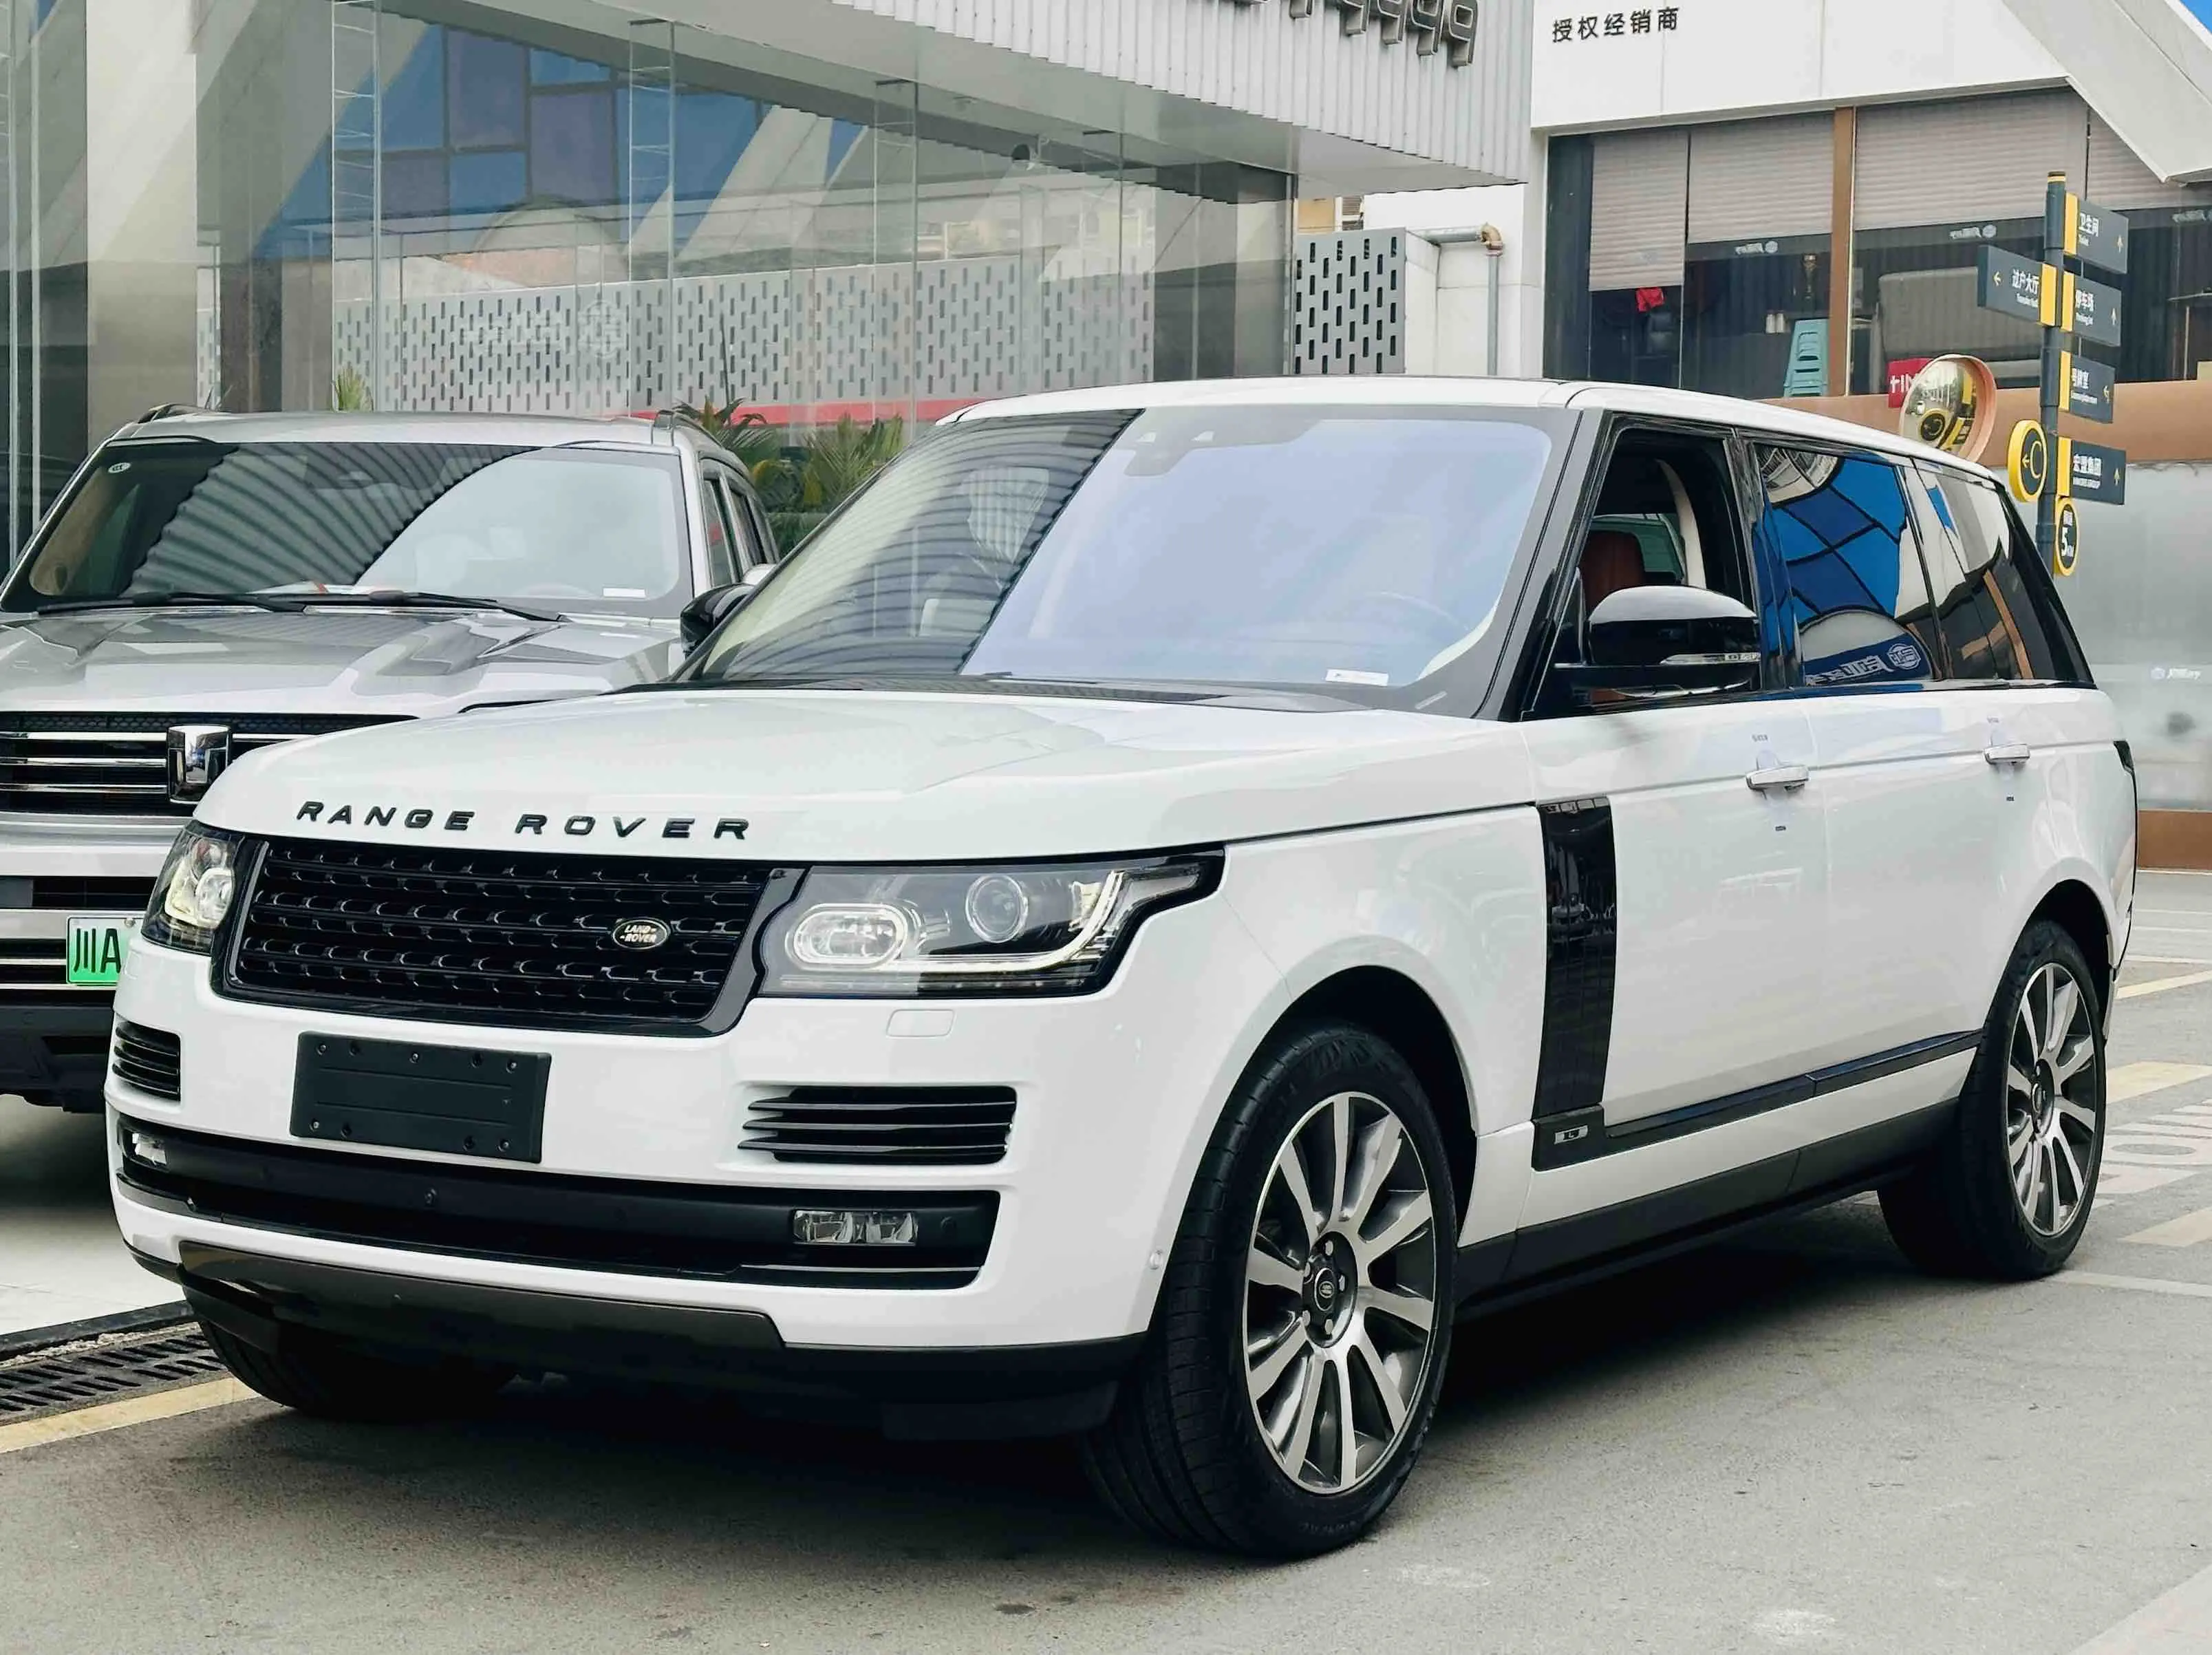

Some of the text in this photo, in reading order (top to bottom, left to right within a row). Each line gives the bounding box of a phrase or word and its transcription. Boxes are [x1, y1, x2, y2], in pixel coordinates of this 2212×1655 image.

[1552, 6, 1679, 43] 授权经销商
[2079, 212, 2099, 237] 卫生间
[297, 800, 749, 840] RANGE ROVER
